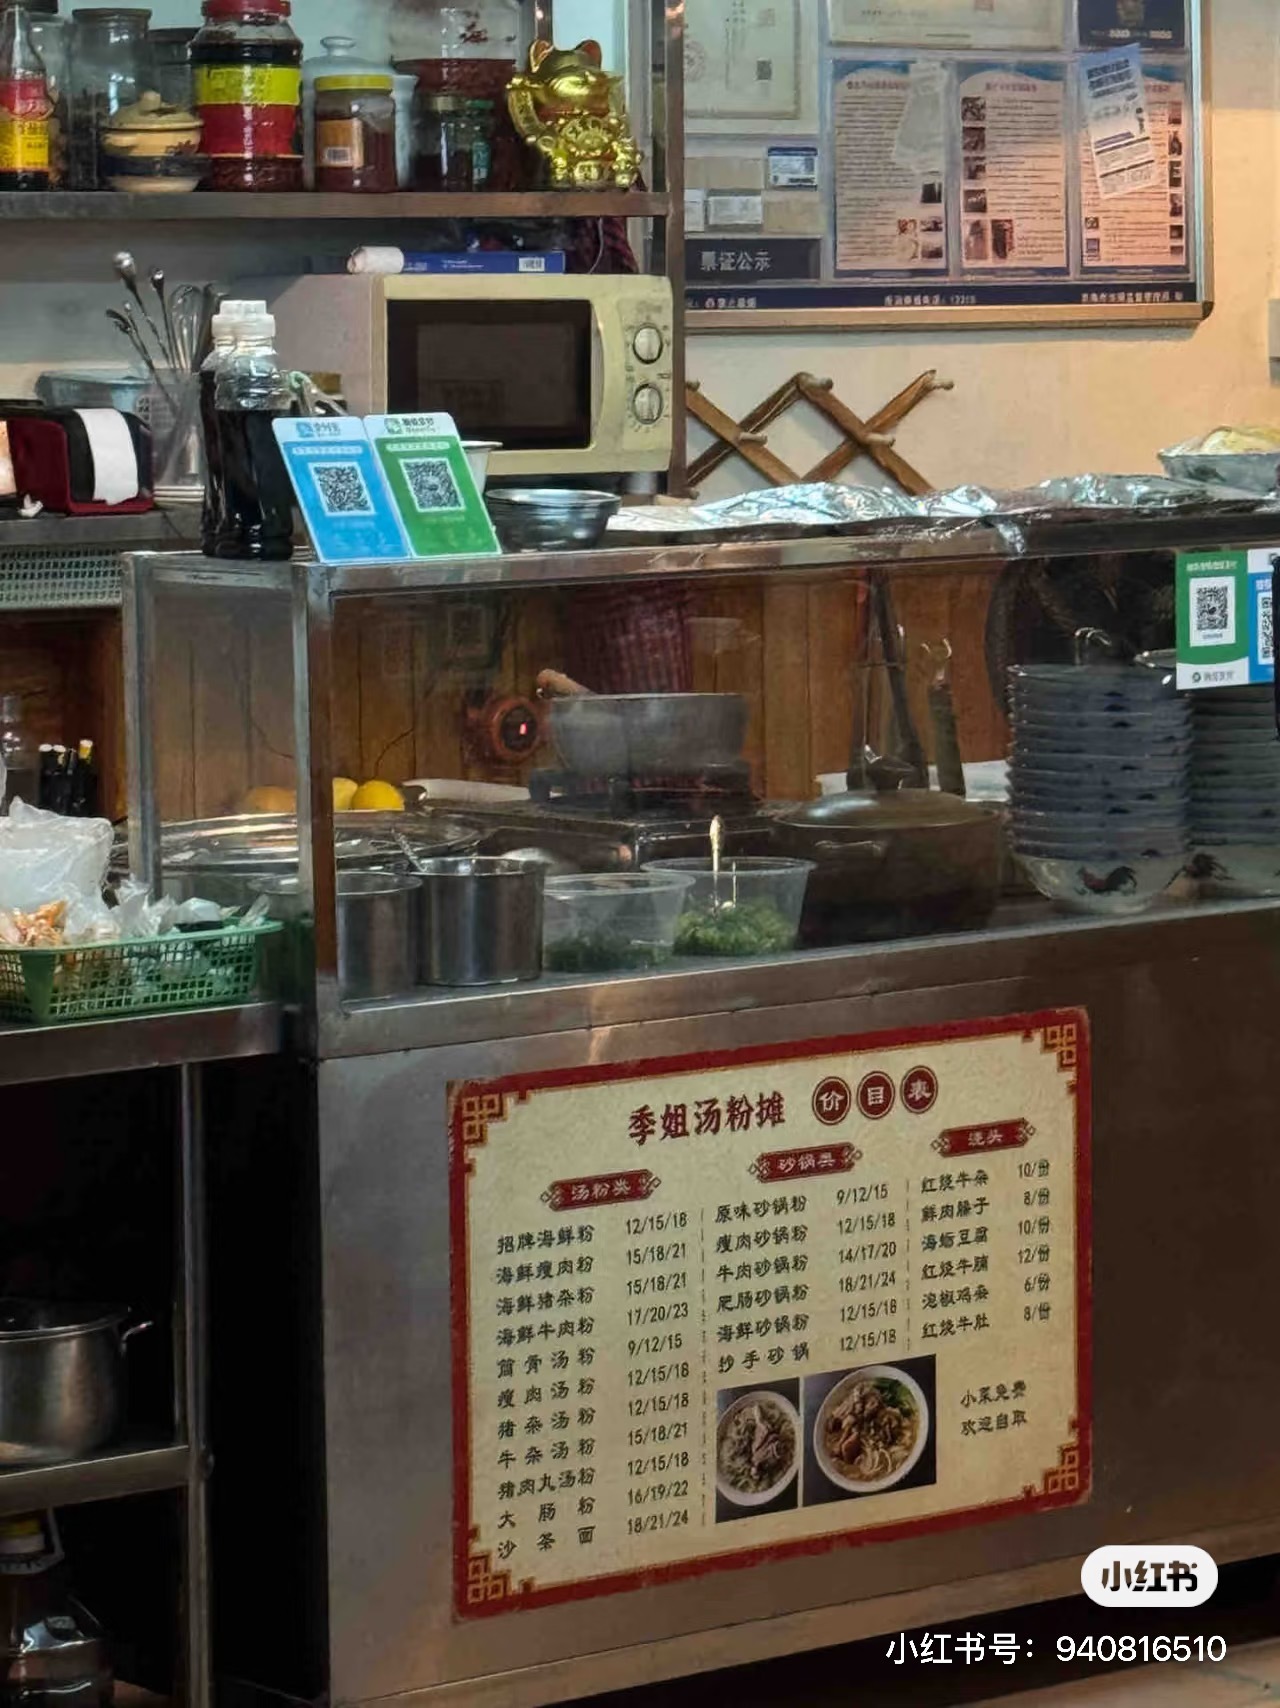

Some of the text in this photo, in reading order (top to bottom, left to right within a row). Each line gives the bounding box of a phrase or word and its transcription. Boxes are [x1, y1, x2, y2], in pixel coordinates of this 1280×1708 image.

[628, 1091, 785, 1146] 季姐汤粉摊
[715, 1183, 888, 1223] 原味砂锅粉 9/12/15
[838, 1212, 896, 1235] 12/15/18
[497, 1212, 688, 1255] 招牌海鲜粉 12/15/18
[496, 1243, 687, 1284] 海鲜瘦肉粉 15/18/21
[716, 1241, 896, 1283] 牛肉砂锅粉 14/17/20
[626, 1272, 687, 1296] 15/18/21
[716, 1271, 896, 1313] 肥肠砂锅粉 18/21/24
[496, 1302, 689, 1346] 海鲜牛肉粉 17/20/23
[717, 1299, 897, 1343] 海鲜砂锅粉 12/15/18
[840, 1328, 896, 1351] 12/15/18
[628, 1333, 683, 1356] 9/12/15
[497, 1362, 689, 1409] 瘦肉汤粉 12/15/18
[628, 1392, 689, 1417] 12/15/18
[497, 1422, 688, 1469] 牛杂汤粉 15/18/21
[497, 1451, 689, 1500] 猪肉丸汤粉 12/15/18
[497, 1480, 689, 1529] 大肠粉 16/19/22
[627, 1510, 689, 1535] 18/21/24
